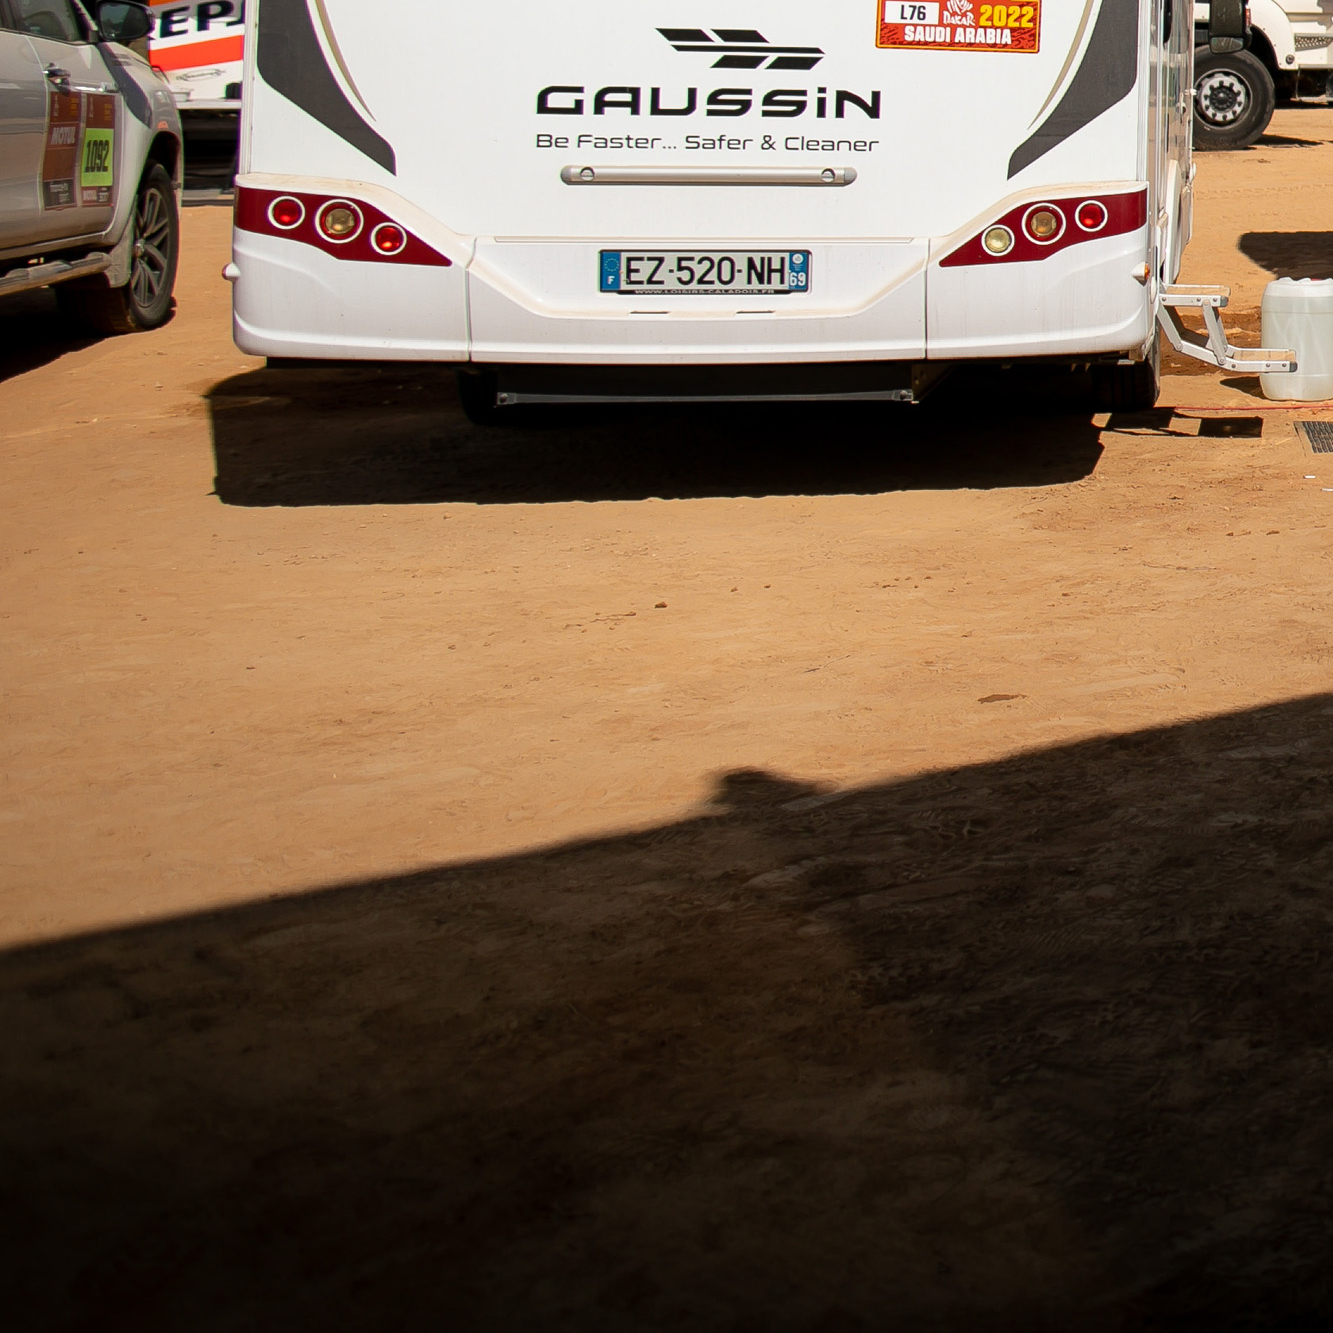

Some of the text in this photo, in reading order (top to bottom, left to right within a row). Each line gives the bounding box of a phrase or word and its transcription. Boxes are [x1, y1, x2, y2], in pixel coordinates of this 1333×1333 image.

[900, 5, 926, 20] L76
[979, 5, 1034, 28] 2022
[904, 26, 1012, 45] SAUDI ARABIA
[536, 134, 880, 152] Be Faster... Safer & Cleaner
[85, 139, 110, 173] 1092
[607, 276, 615, 284] F
[625, 256, 785, 285] EZ-520-NH
[789, 272, 806, 286] 69
